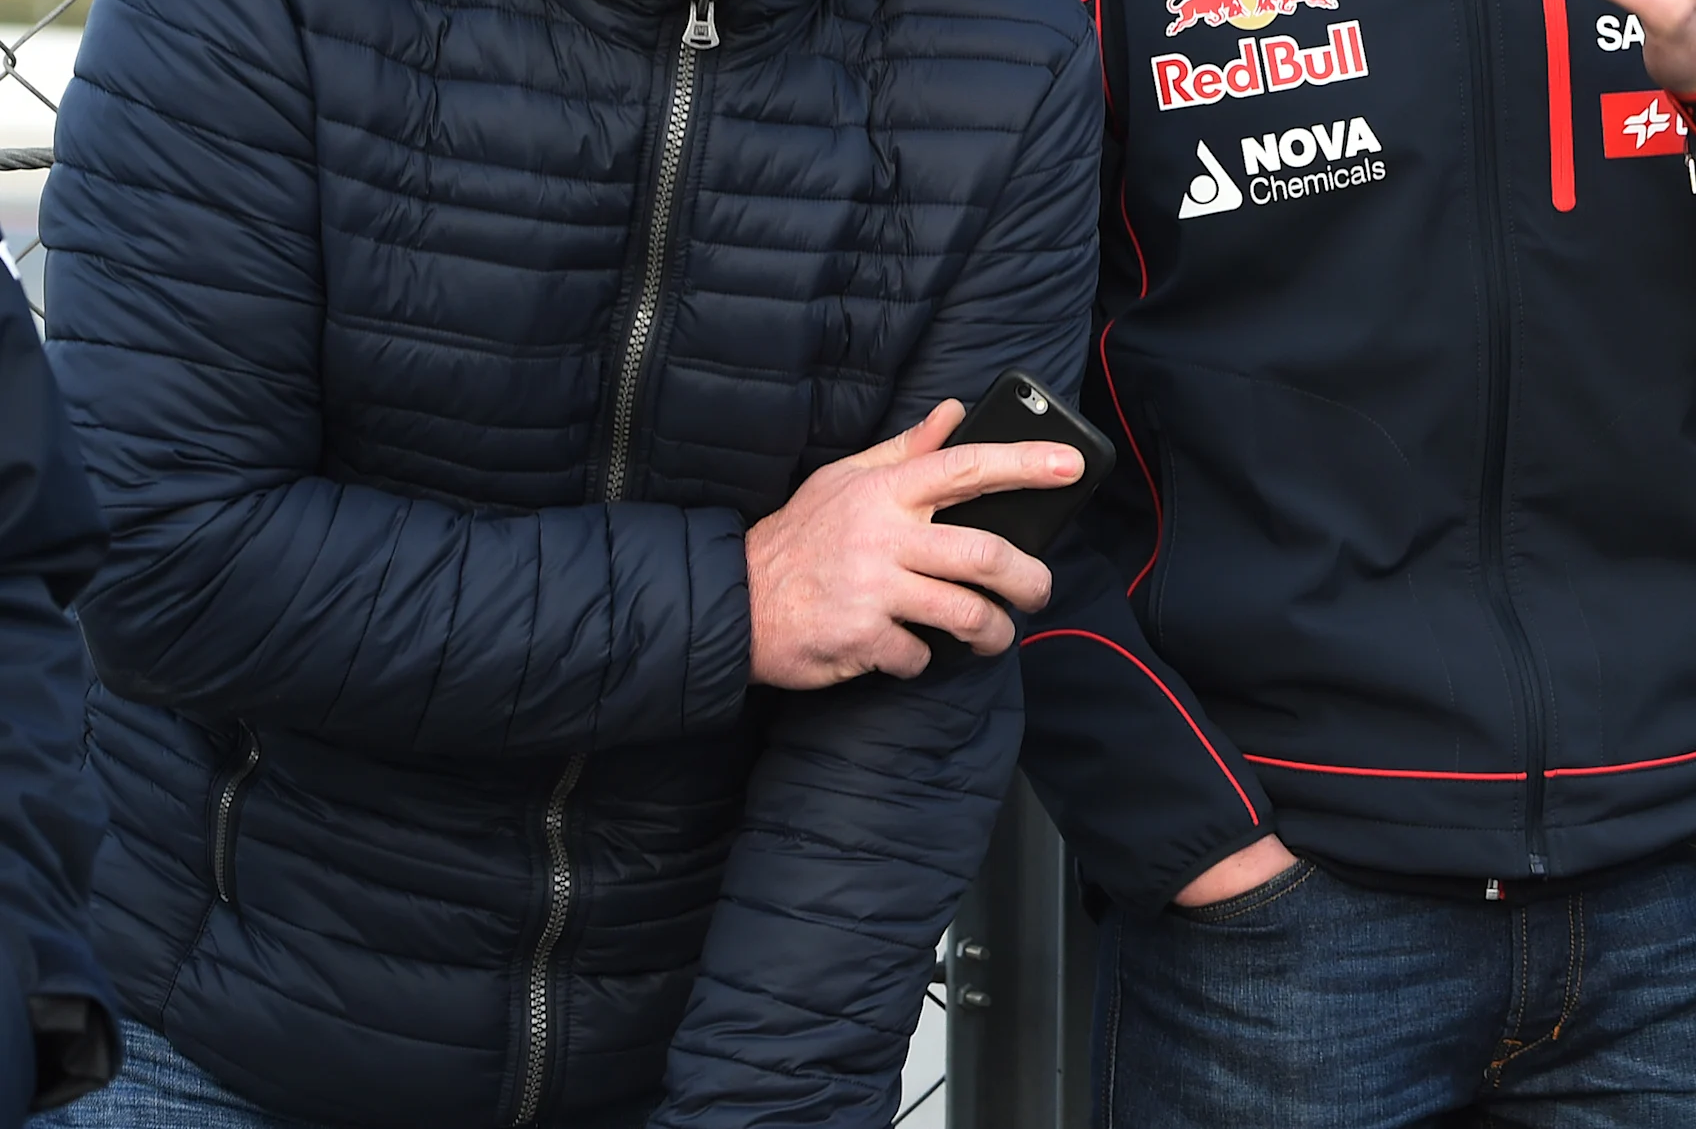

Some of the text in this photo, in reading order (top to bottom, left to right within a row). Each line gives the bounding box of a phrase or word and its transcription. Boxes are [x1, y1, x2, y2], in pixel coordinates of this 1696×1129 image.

[1595, 14, 1645, 52] SA
[1151, 19, 1369, 111] Red Bull
[1240, 117, 1382, 175] NOVA
[1249, 157, 1386, 205] Chemicals
